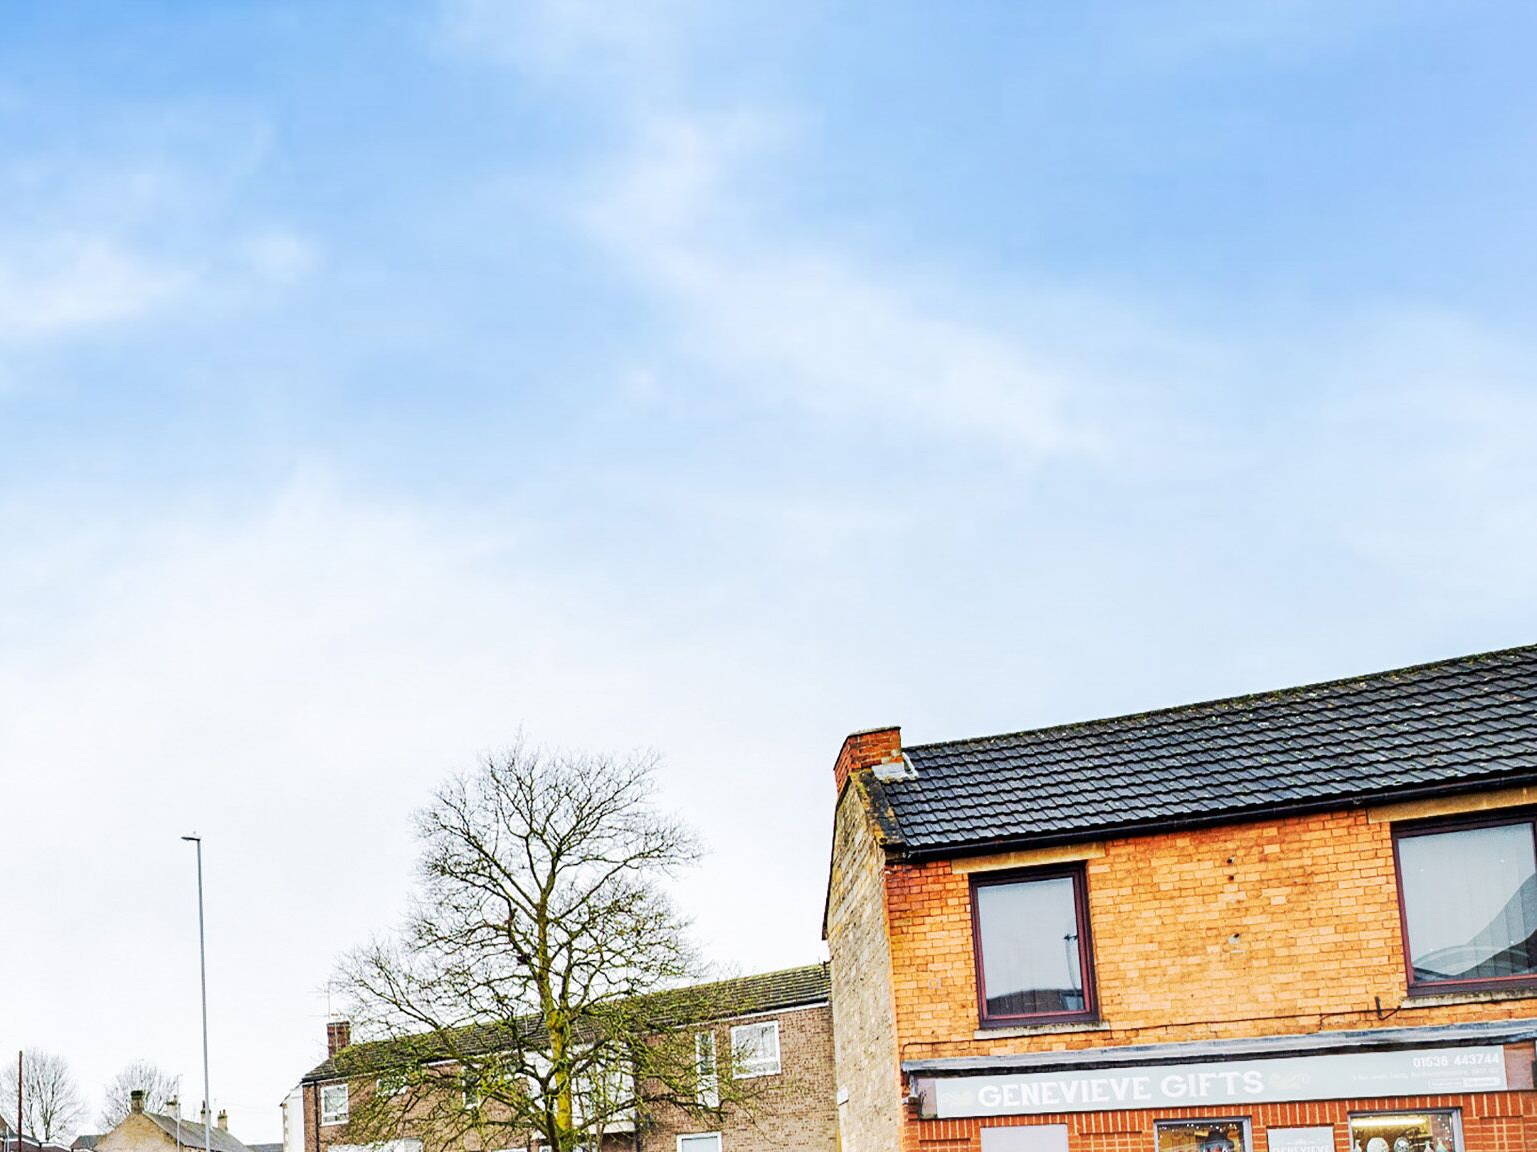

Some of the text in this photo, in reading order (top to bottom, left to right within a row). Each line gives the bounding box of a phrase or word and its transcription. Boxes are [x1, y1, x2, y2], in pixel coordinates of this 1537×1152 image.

[1454, 1053, 1499, 1066] 443744
[978, 1070, 1264, 1108] GENEVIEVE GIFTS
